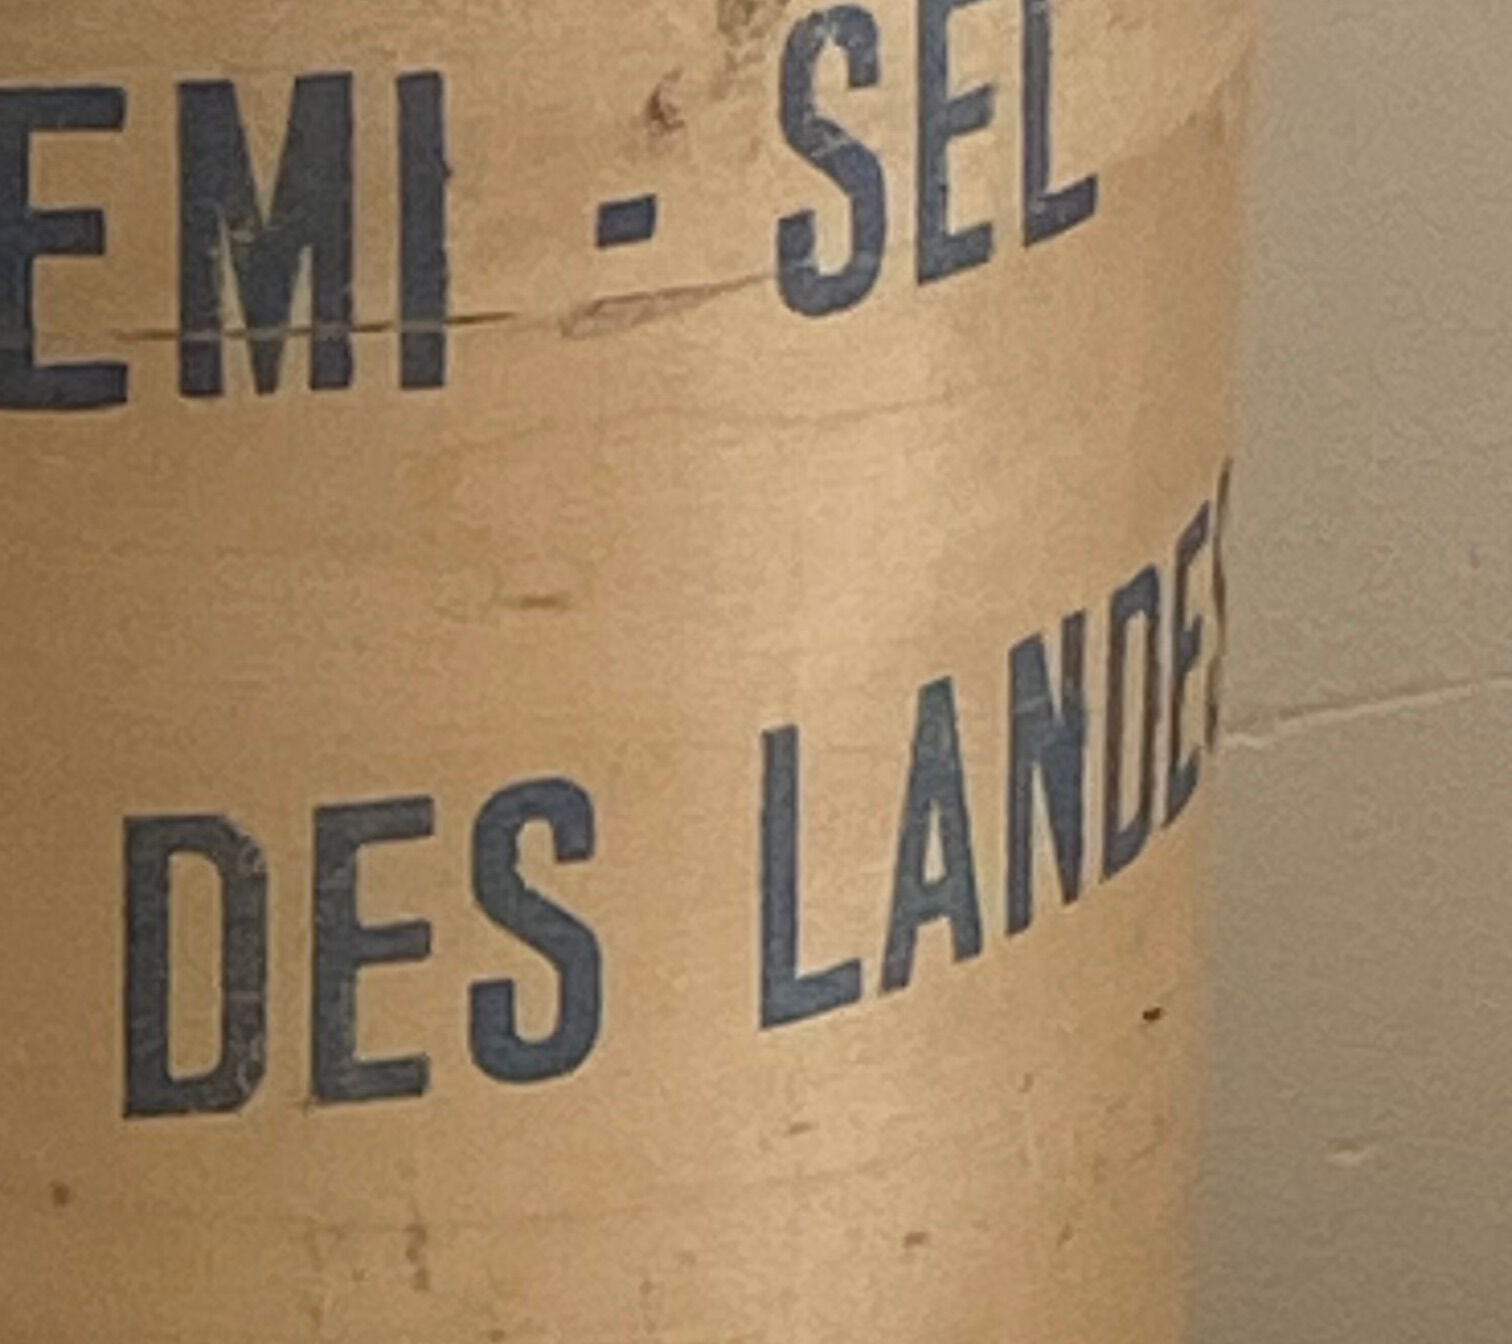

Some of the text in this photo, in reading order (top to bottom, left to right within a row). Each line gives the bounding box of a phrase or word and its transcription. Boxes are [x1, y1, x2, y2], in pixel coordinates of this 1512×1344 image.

[596, 194, 658, 245] -
[124, 776, 604, 1115] DES
[759, 458, 1232, 1030] LANDE
